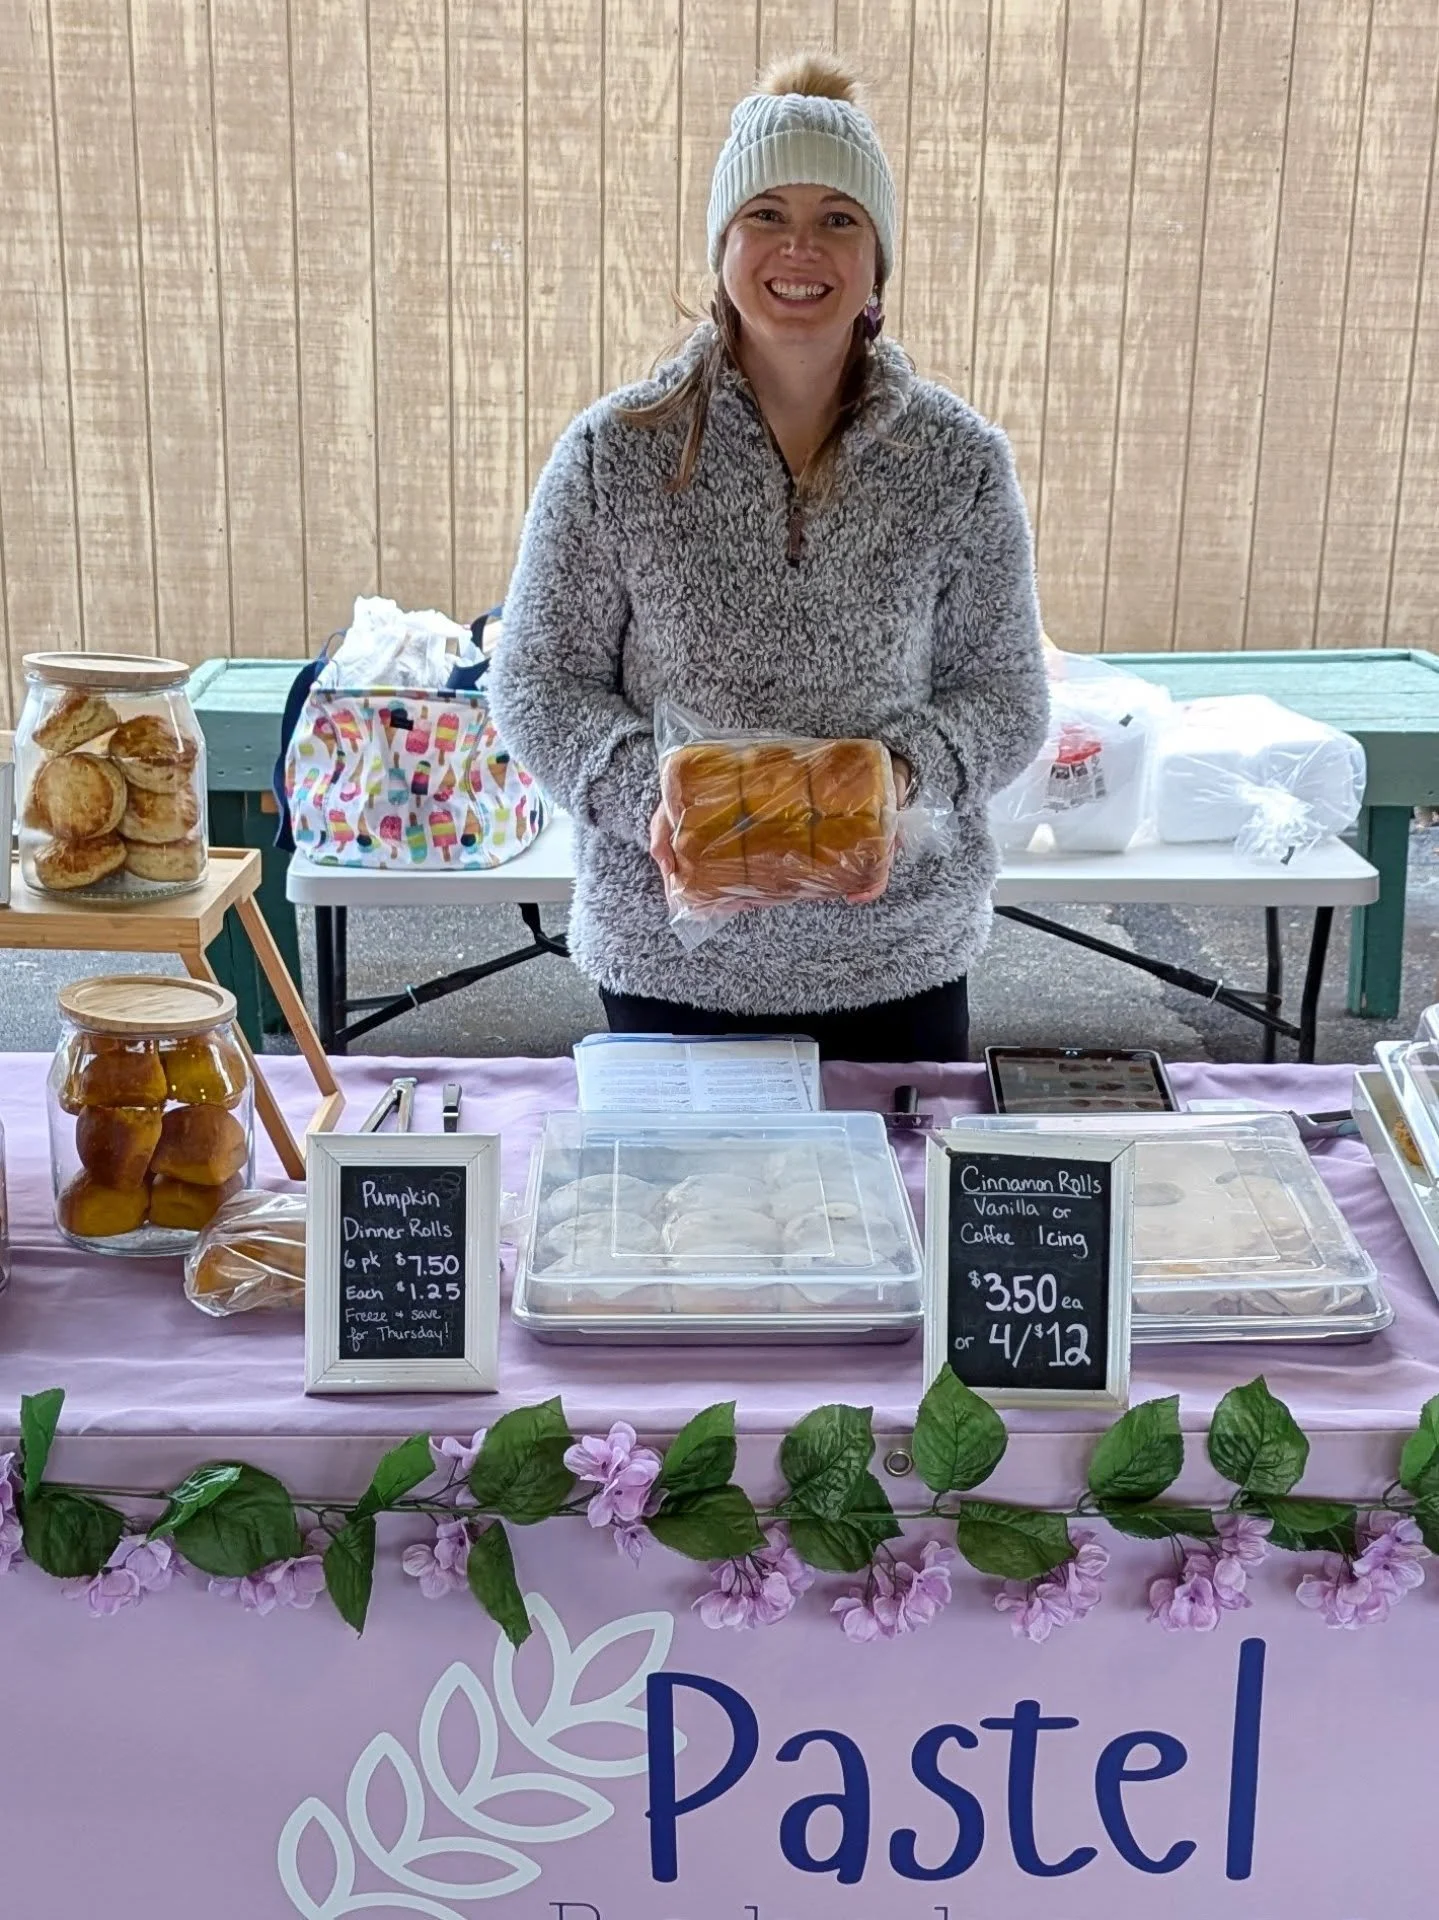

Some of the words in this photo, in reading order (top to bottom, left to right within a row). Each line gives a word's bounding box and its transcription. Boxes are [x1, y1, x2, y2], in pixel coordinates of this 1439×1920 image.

[961, 1165, 1053, 1193] Cinnamon
[1058, 1170, 1102, 1195] Rolls
[362, 1180, 440, 1217] Pumpkin
[974, 1196, 1040, 1217] Vanilla
[1053, 1206, 1072, 1219] or
[343, 1216, 405, 1242] Dinner
[409, 1218, 453, 1238] Rolls
[960, 1222, 1015, 1246] Coffee
[1038, 1225, 1089, 1259] Icing
[343, 1249, 356, 1269] 6
[361, 1250, 381, 1274] pk
[395, 1251, 460, 1277] $7.50
[345, 1285, 384, 1301] Each
[967, 1269, 1058, 1314] $3.50
[1061, 1295, 1084, 1310] ea
[344, 1307, 388, 1323] Freeze
[411, 1308, 442, 1321] save
[346, 1326, 369, 1352] for
[377, 1321, 449, 1347] Thursday!
[954, 1335, 975, 1350] or
[645, 1637, 1267, 1884] Pastel
